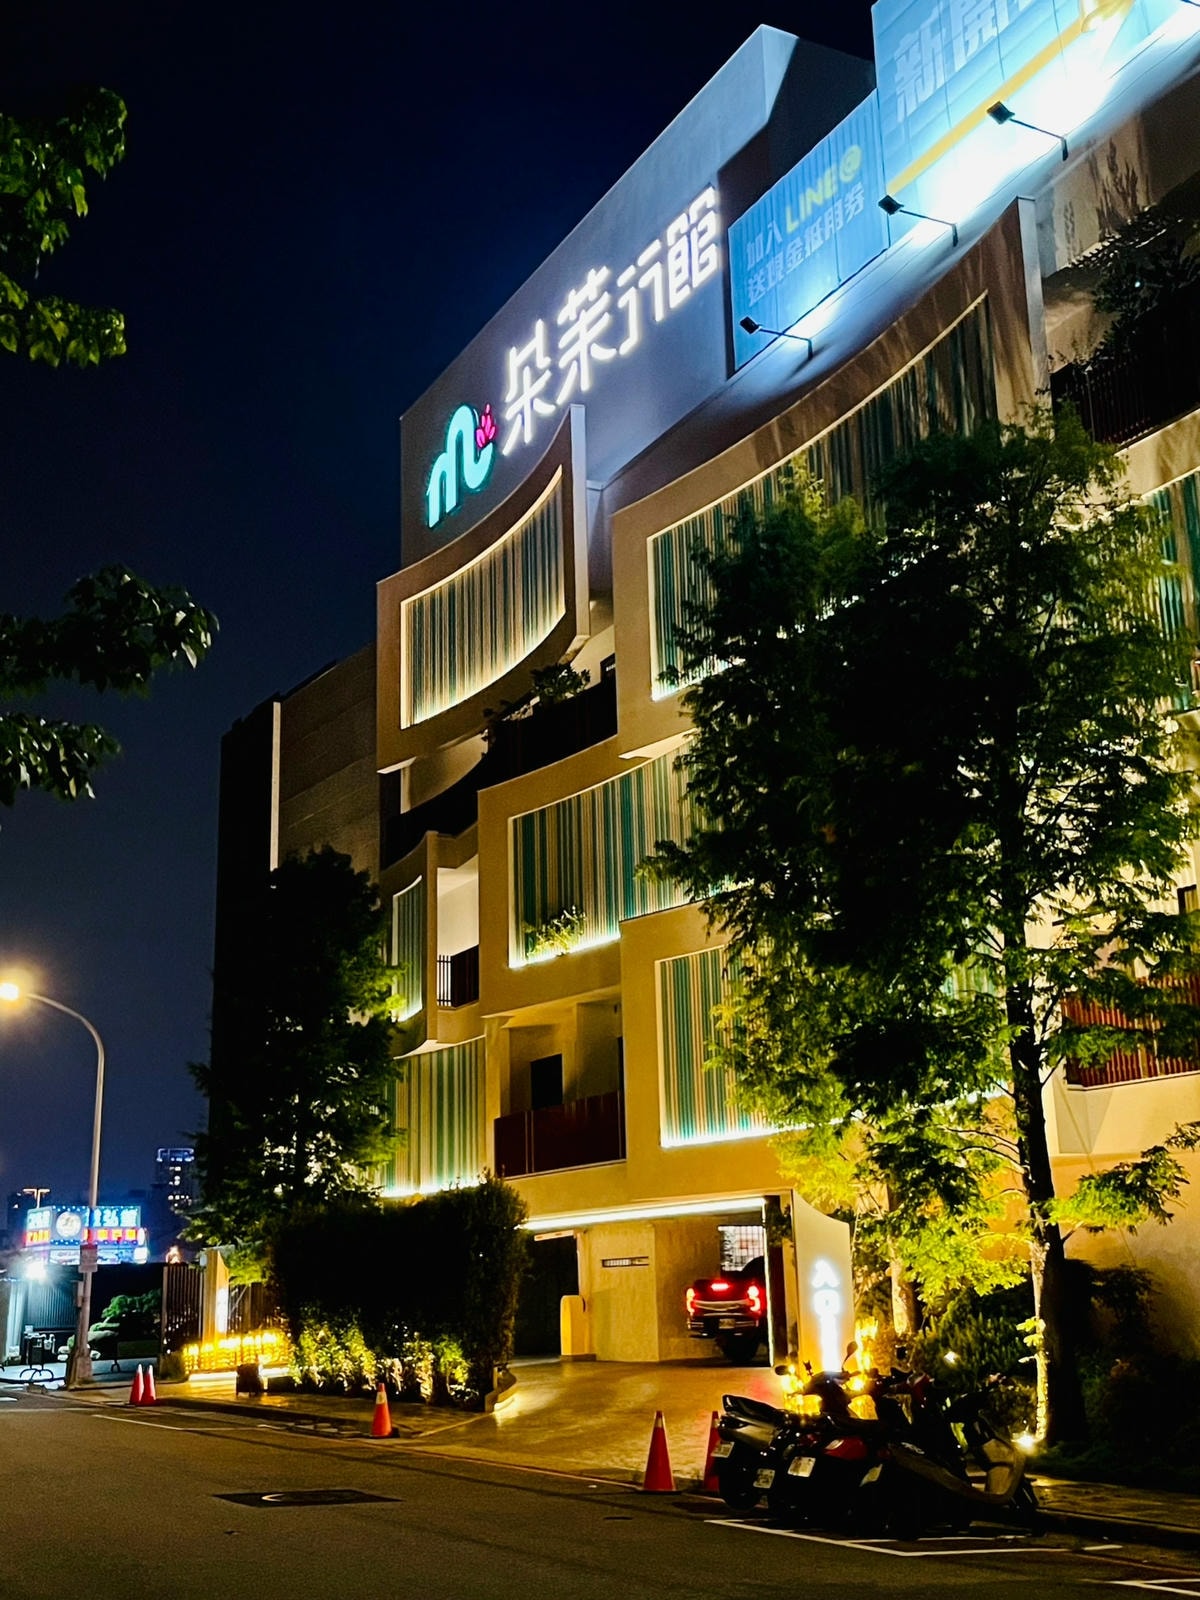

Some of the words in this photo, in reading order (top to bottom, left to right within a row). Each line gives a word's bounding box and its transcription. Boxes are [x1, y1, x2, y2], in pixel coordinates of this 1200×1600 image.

[746, 220, 783, 271] 加入
[785, 145, 862, 234] LINE@
[747, 182, 865, 307] 送現金抵用券
